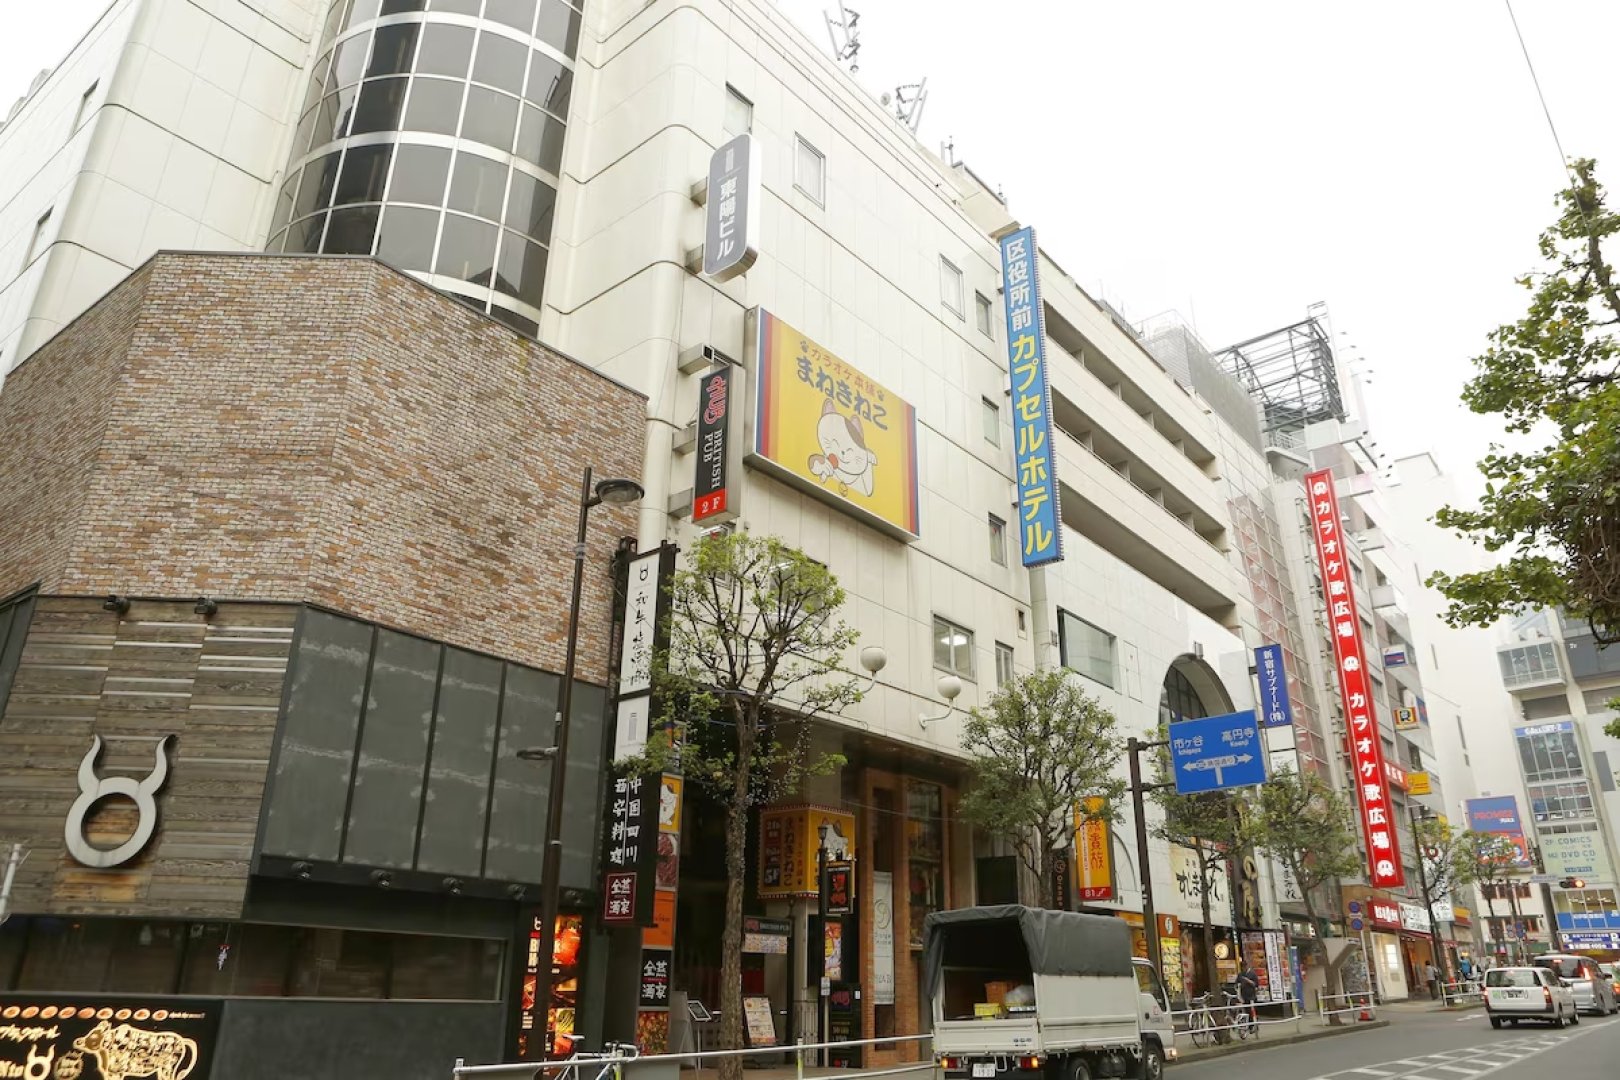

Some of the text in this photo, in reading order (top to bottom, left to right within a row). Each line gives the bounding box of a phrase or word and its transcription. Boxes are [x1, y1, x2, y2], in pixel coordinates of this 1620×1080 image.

[717, 176, 738, 261] 東陽ビル
[796, 355, 889, 431] まねきねこ
[1006, 236, 1053, 556] 区役所前カプセルホテル
[703, 432, 714, 463] PUB
[711, 428, 723, 489] BRITISH
[701, 496, 721, 514] 2F
[1315, 500, 1355, 638] カラオケ歌広場
[1264, 650, 1285, 722] 新宿サブナード(株)
[1221, 727, 1254, 742] 高円寺
[1348, 691, 1390, 849] カラオケ歌広場
[626, 778, 642, 862] 中国四川
[783, 817, 795, 887] まねきねこ
[1557, 836, 1592, 845] COMICS
[1084, 888, 1096, 899] B1
